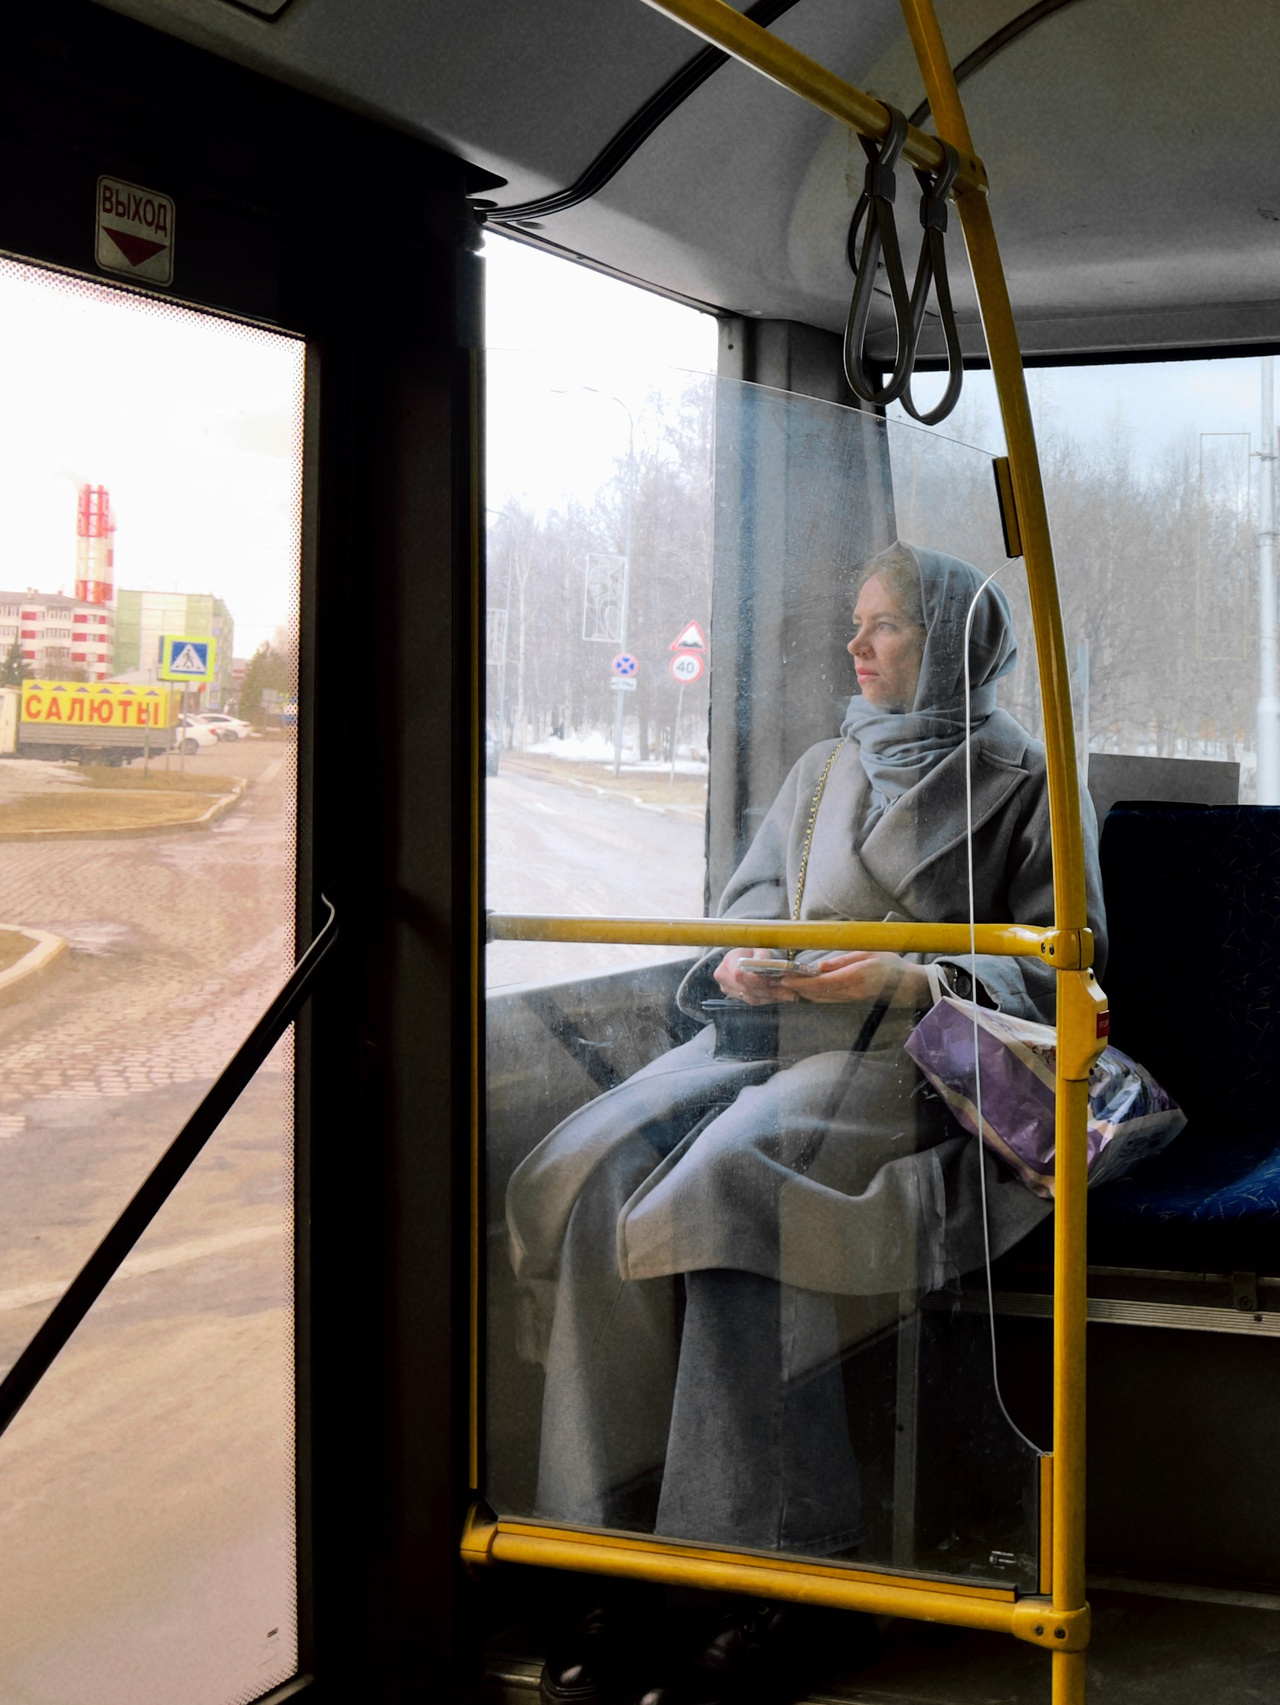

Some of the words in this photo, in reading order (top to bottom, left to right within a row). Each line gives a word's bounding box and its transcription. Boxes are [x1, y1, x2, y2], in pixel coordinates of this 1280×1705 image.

[102, 184, 167, 238] ВЫХОД
[676, 661, 695, 674] 40
[25, 694, 159, 725] САЛЮТЫ
